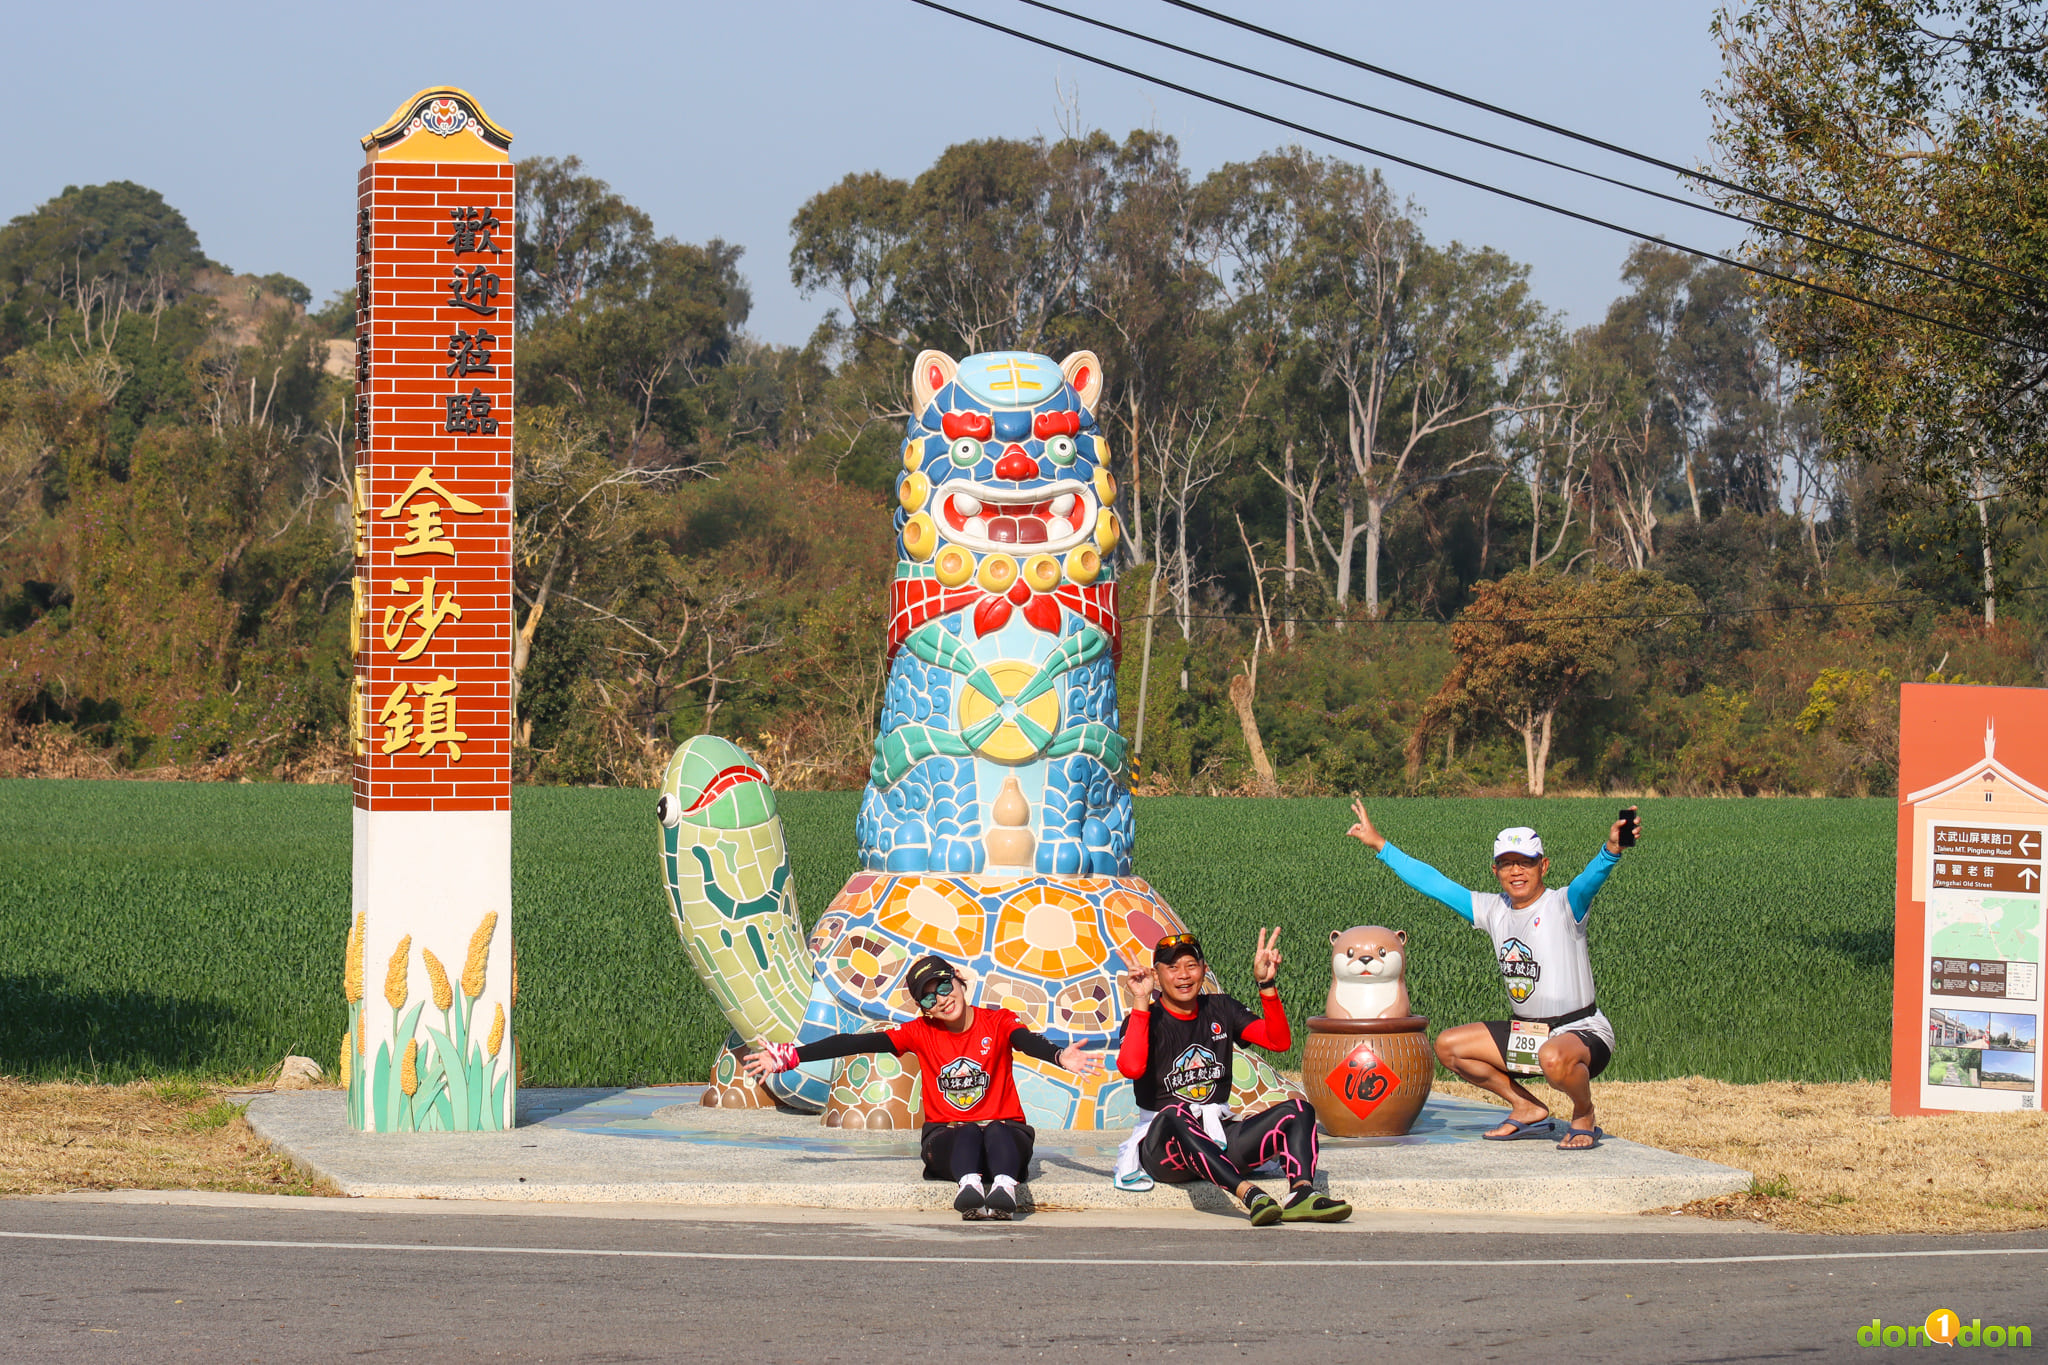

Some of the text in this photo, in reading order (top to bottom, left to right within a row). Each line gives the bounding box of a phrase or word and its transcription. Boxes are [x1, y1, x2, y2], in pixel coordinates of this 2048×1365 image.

[445, 206, 502, 435] 歡迎蒞臨
[378, 466, 483, 761] 金沙鎮
[1936, 830, 2012, 845] 太武山屏東路口
[1967, 847, 1995, 856] Pingtung
[1996, 848, 2012, 856] Road
[1515, 1035, 1536, 1051] 289
